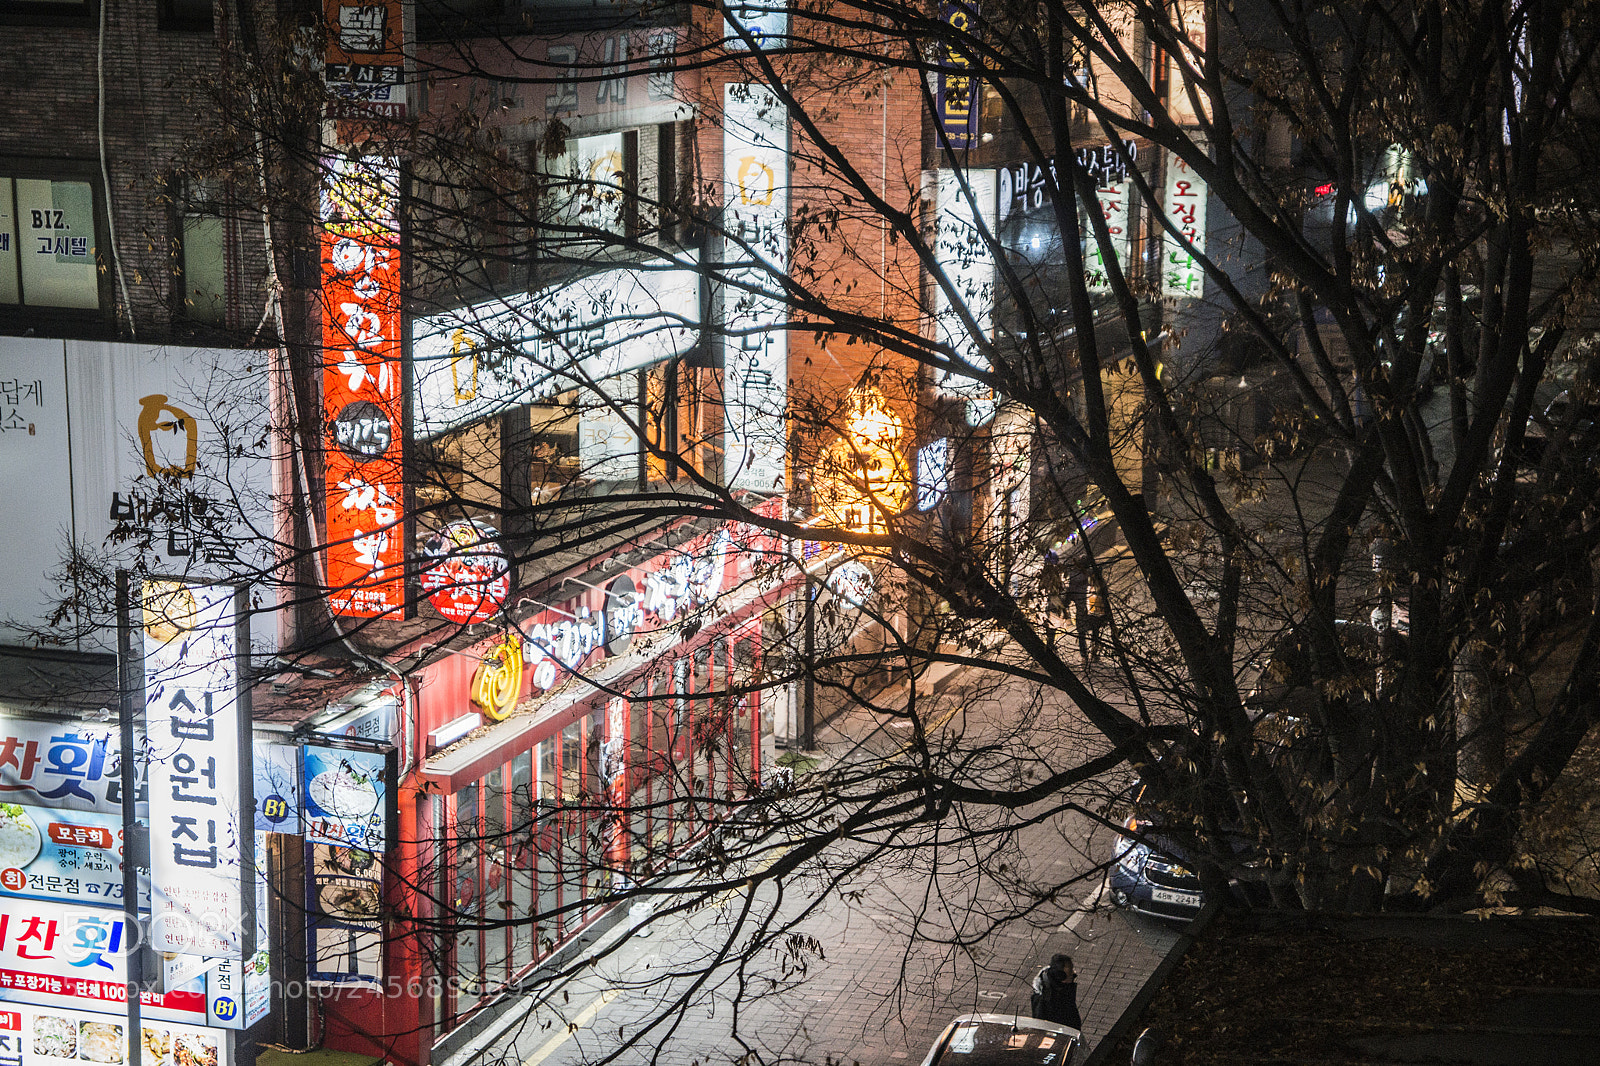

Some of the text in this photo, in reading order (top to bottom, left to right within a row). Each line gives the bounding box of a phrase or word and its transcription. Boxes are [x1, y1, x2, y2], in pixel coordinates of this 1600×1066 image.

[31, 209, 70, 230] BIZ.
[37, 237, 87, 256] 고시텔
[0, 378, 43, 407] 답게
[0, 406, 27, 433] 소
[168, 688, 218, 869] 십원집
[265, 799, 286, 818] B1
[57, 826, 104, 846] 모듬회
[4, 871, 22, 889] 회
[28, 874, 80, 895] 전문점
[0, 914, 125, 972] 찬횟
[14, 974, 62, 993] 포장가능
[76, 981, 101, 999] 단체
[215, 1000, 236, 1017] B1
